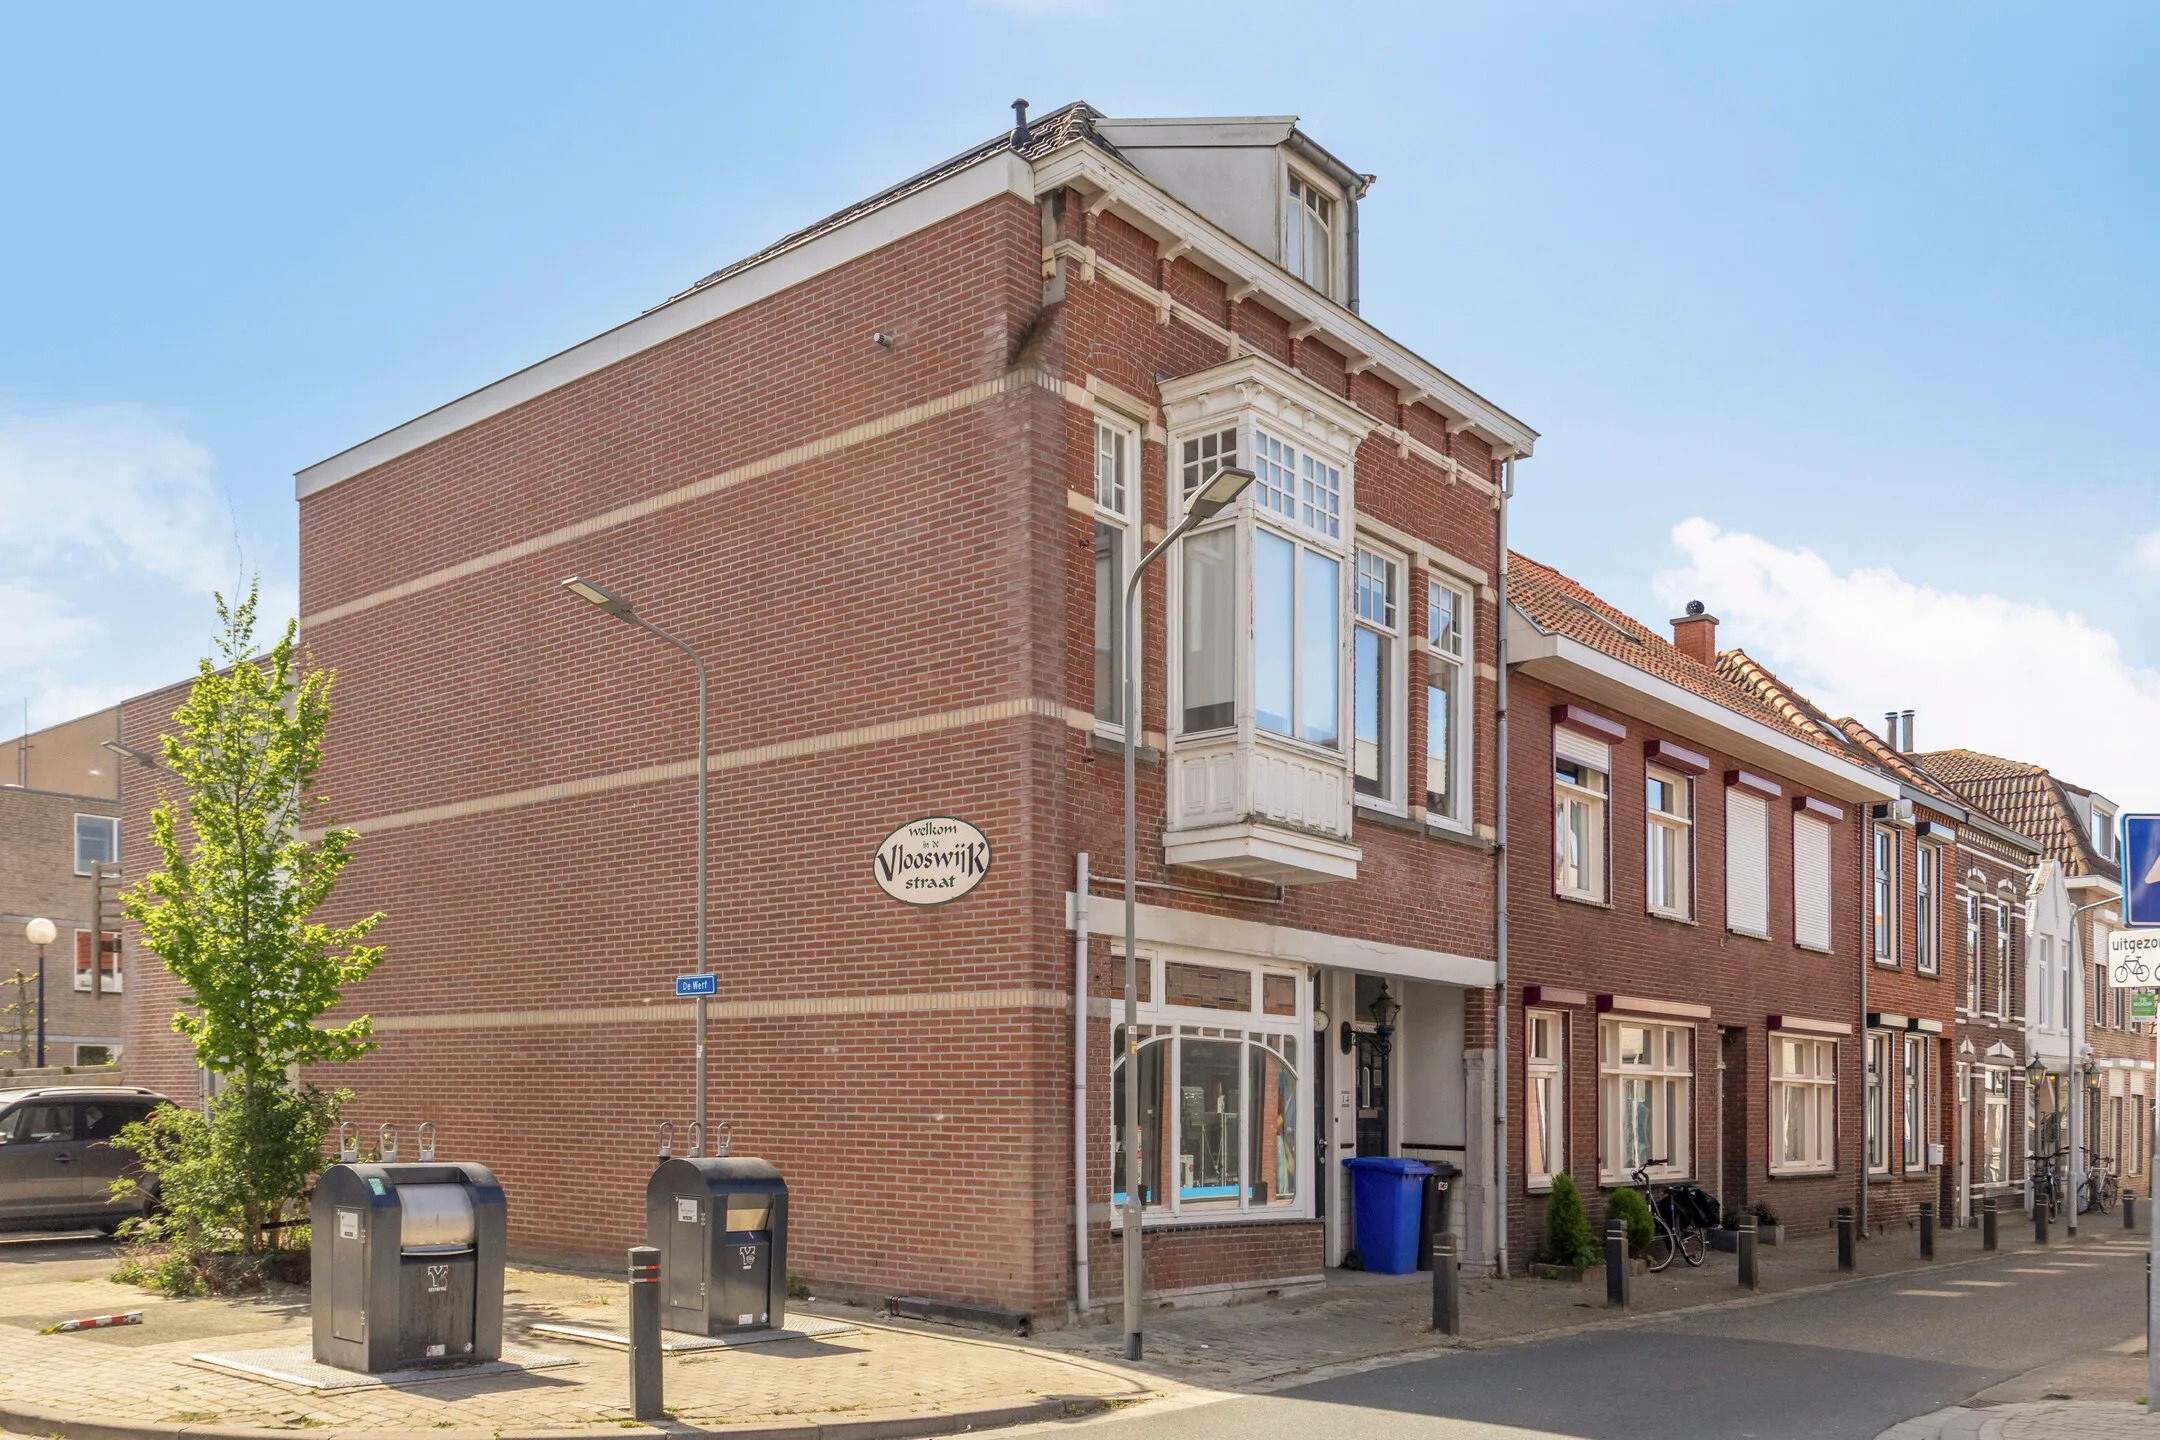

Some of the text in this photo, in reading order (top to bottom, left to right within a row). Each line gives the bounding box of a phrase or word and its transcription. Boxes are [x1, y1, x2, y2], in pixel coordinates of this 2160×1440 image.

[908, 822, 957, 836] welkom
[906, 875, 956, 889] straat
[682, 982, 691, 991] De
